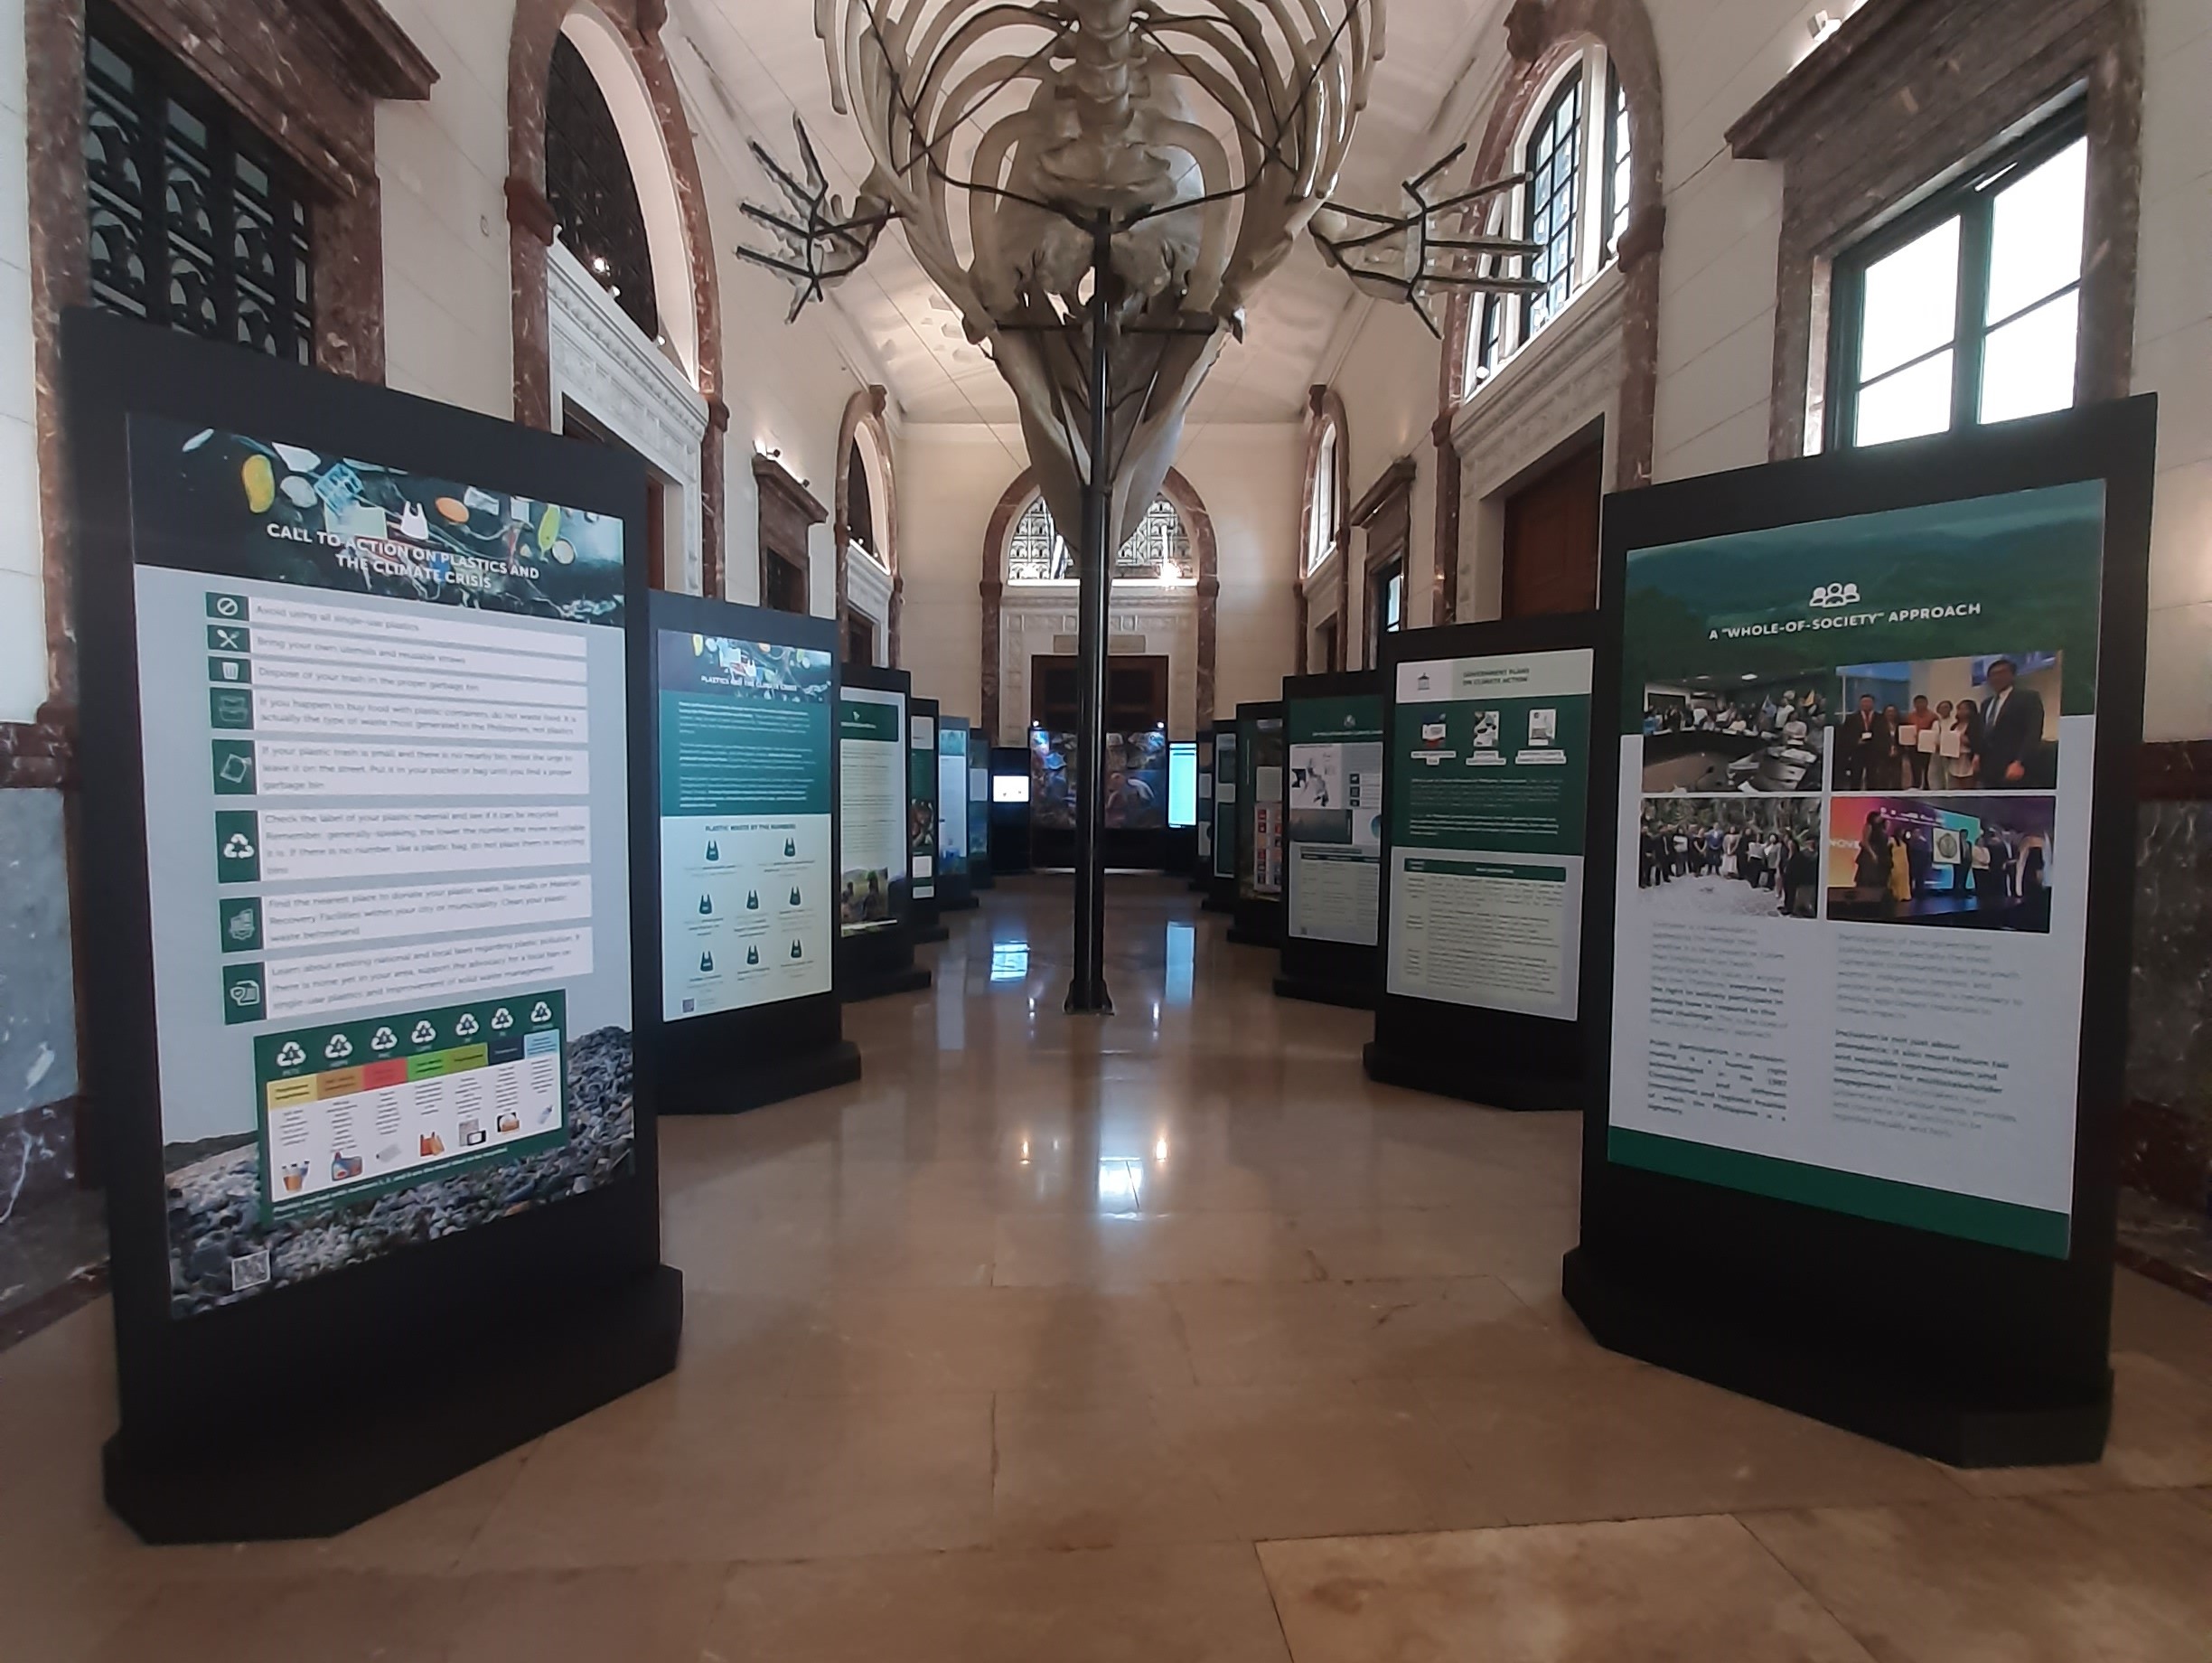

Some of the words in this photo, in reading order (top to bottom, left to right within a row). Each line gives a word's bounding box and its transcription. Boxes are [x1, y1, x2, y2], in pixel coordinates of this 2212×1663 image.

[267, 523, 313, 543] CALL
[316, 531, 342, 547] TO
[344, 540, 412, 559] ACTION
[413, 549, 437, 562] ON
[440, 552, 508, 574] PLASTICS
[510, 565, 539, 579] AND
[336, 553, 369, 570] THE
[373, 559, 442, 580] CLIMATE
[445, 571, 492, 588] CRISIS
[1709, 629, 1718, 640] A
[1889, 602, 1982, 623] APPROACH
